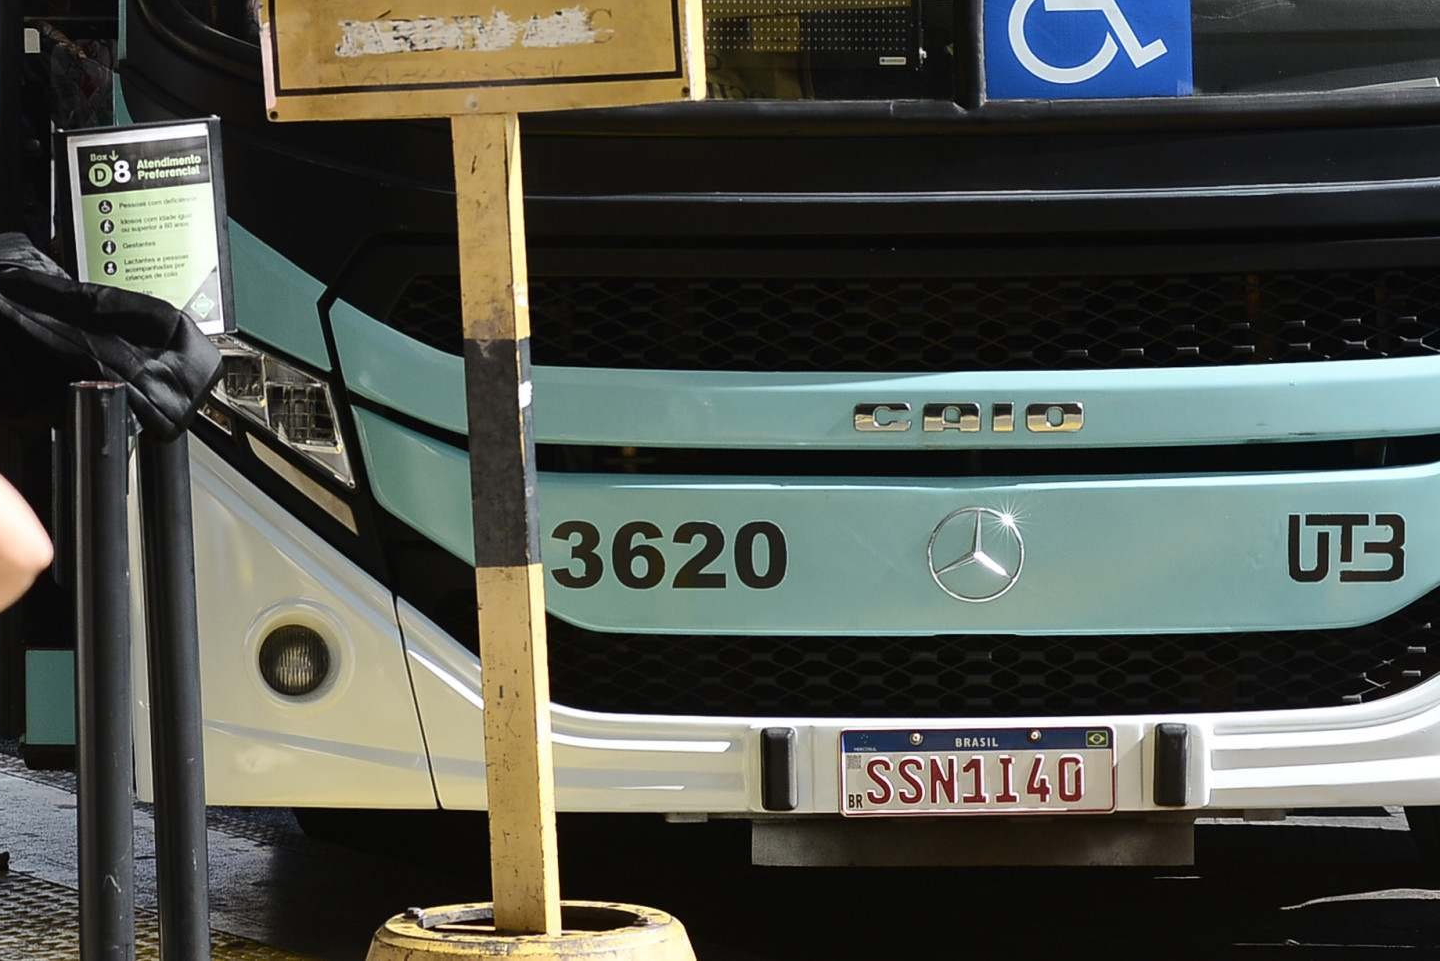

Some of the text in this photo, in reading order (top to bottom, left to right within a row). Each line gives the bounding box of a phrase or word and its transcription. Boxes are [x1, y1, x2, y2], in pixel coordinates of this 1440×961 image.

[90, 153, 108, 162] Box
[137, 154, 202, 169] Atendimento
[137, 165, 201, 180] Preferencial
[853, 401, 1085, 432] CAIO
[550, 520, 788, 589] 3620
[1288, 514, 1405, 582] UTB
[955, 737, 999, 748] BRASIL
[866, 753, 1085, 804] SSN1I40
[848, 794, 863, 809] BR
